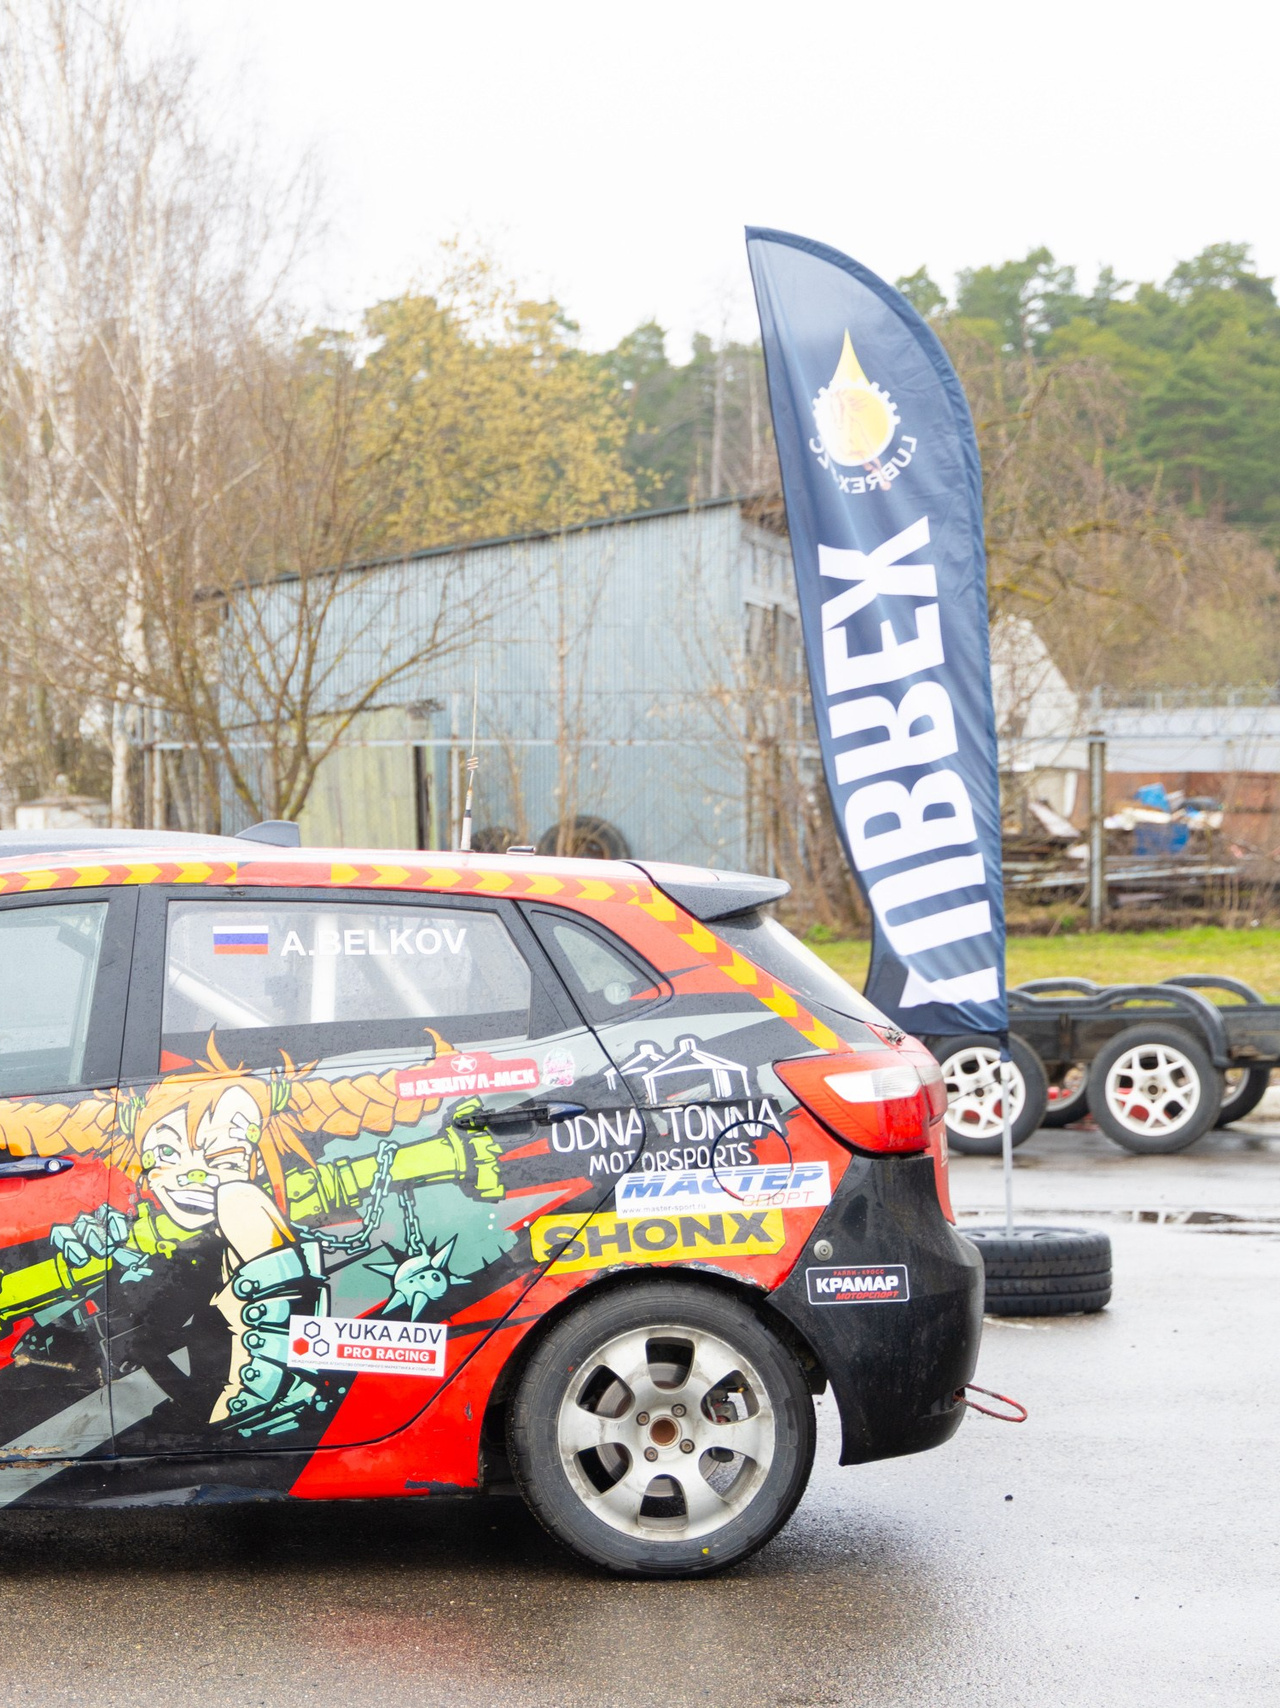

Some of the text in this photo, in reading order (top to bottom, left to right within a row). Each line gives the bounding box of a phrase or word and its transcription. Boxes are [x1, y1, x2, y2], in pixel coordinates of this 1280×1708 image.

[280, 928, 467, 957] A.BELKOV
[662, 1100, 783, 1143] TONNA
[589, 1142, 753, 1176] MOTORSPORTS
[621, 1165, 824, 1200] МАСТЕР
[621, 1202, 707, 1214] www.master-sport.ru
[741, 1190, 815, 1208] СПОРТ
[543, 1212, 774, 1262] SHONX
[816, 1275, 899, 1293] КРАМАР
[835, 1290, 899, 1301] МОТОРСПОРТ
[334, 1322, 442, 1344] YUKA ADV
[344, 1346, 430, 1362] PRO RACING
